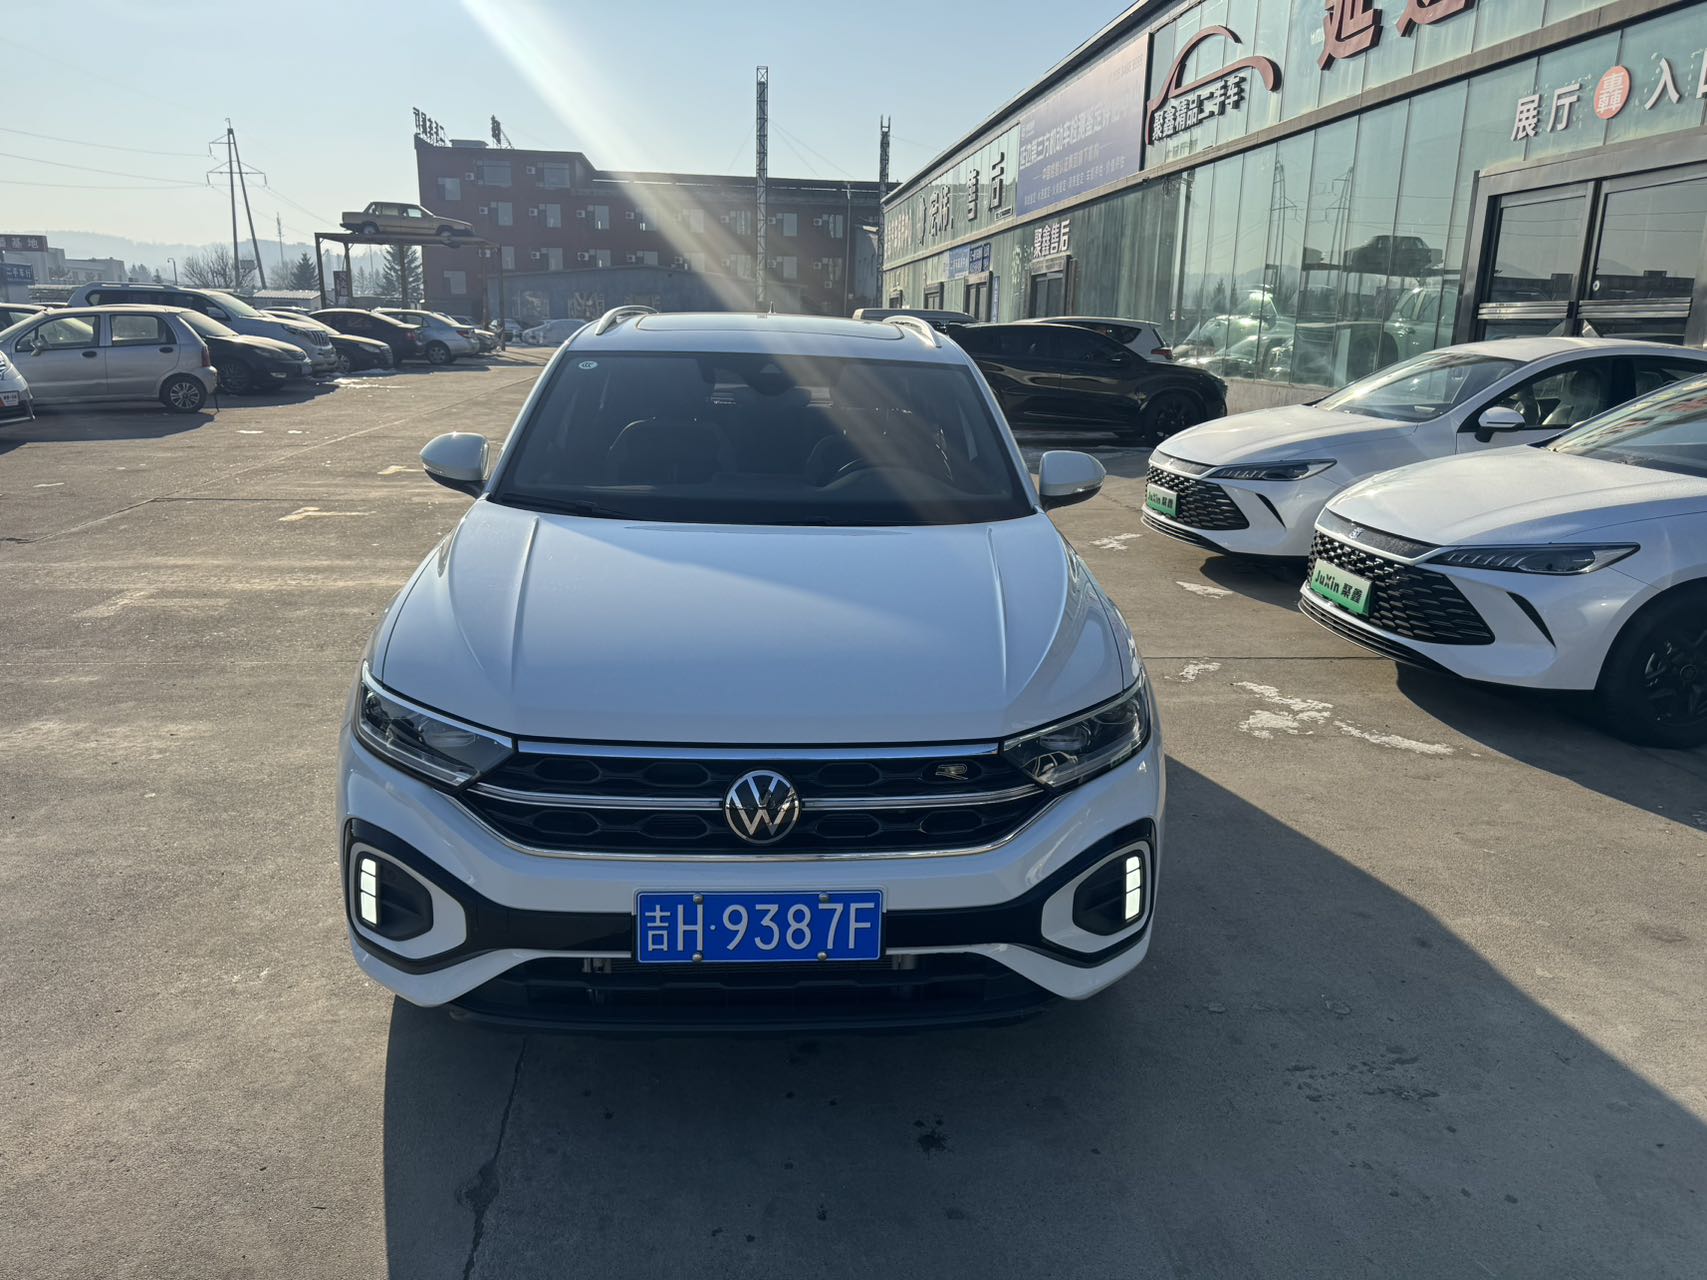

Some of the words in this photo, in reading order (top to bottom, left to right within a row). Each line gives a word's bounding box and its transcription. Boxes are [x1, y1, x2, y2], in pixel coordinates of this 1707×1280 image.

[1152, 74, 1243, 141] 聚鑫精品二手车
[1510, 83, 1581, 141] 展厅
[1033, 218, 1070, 258] 聚鑫售后
[1147, 491, 1161, 504] JuXin
[1315, 569, 1340, 594] JuXin
[1341, 582, 1363, 604] 聚鑫
[644, 902, 876, 952] 吉H·9387F
